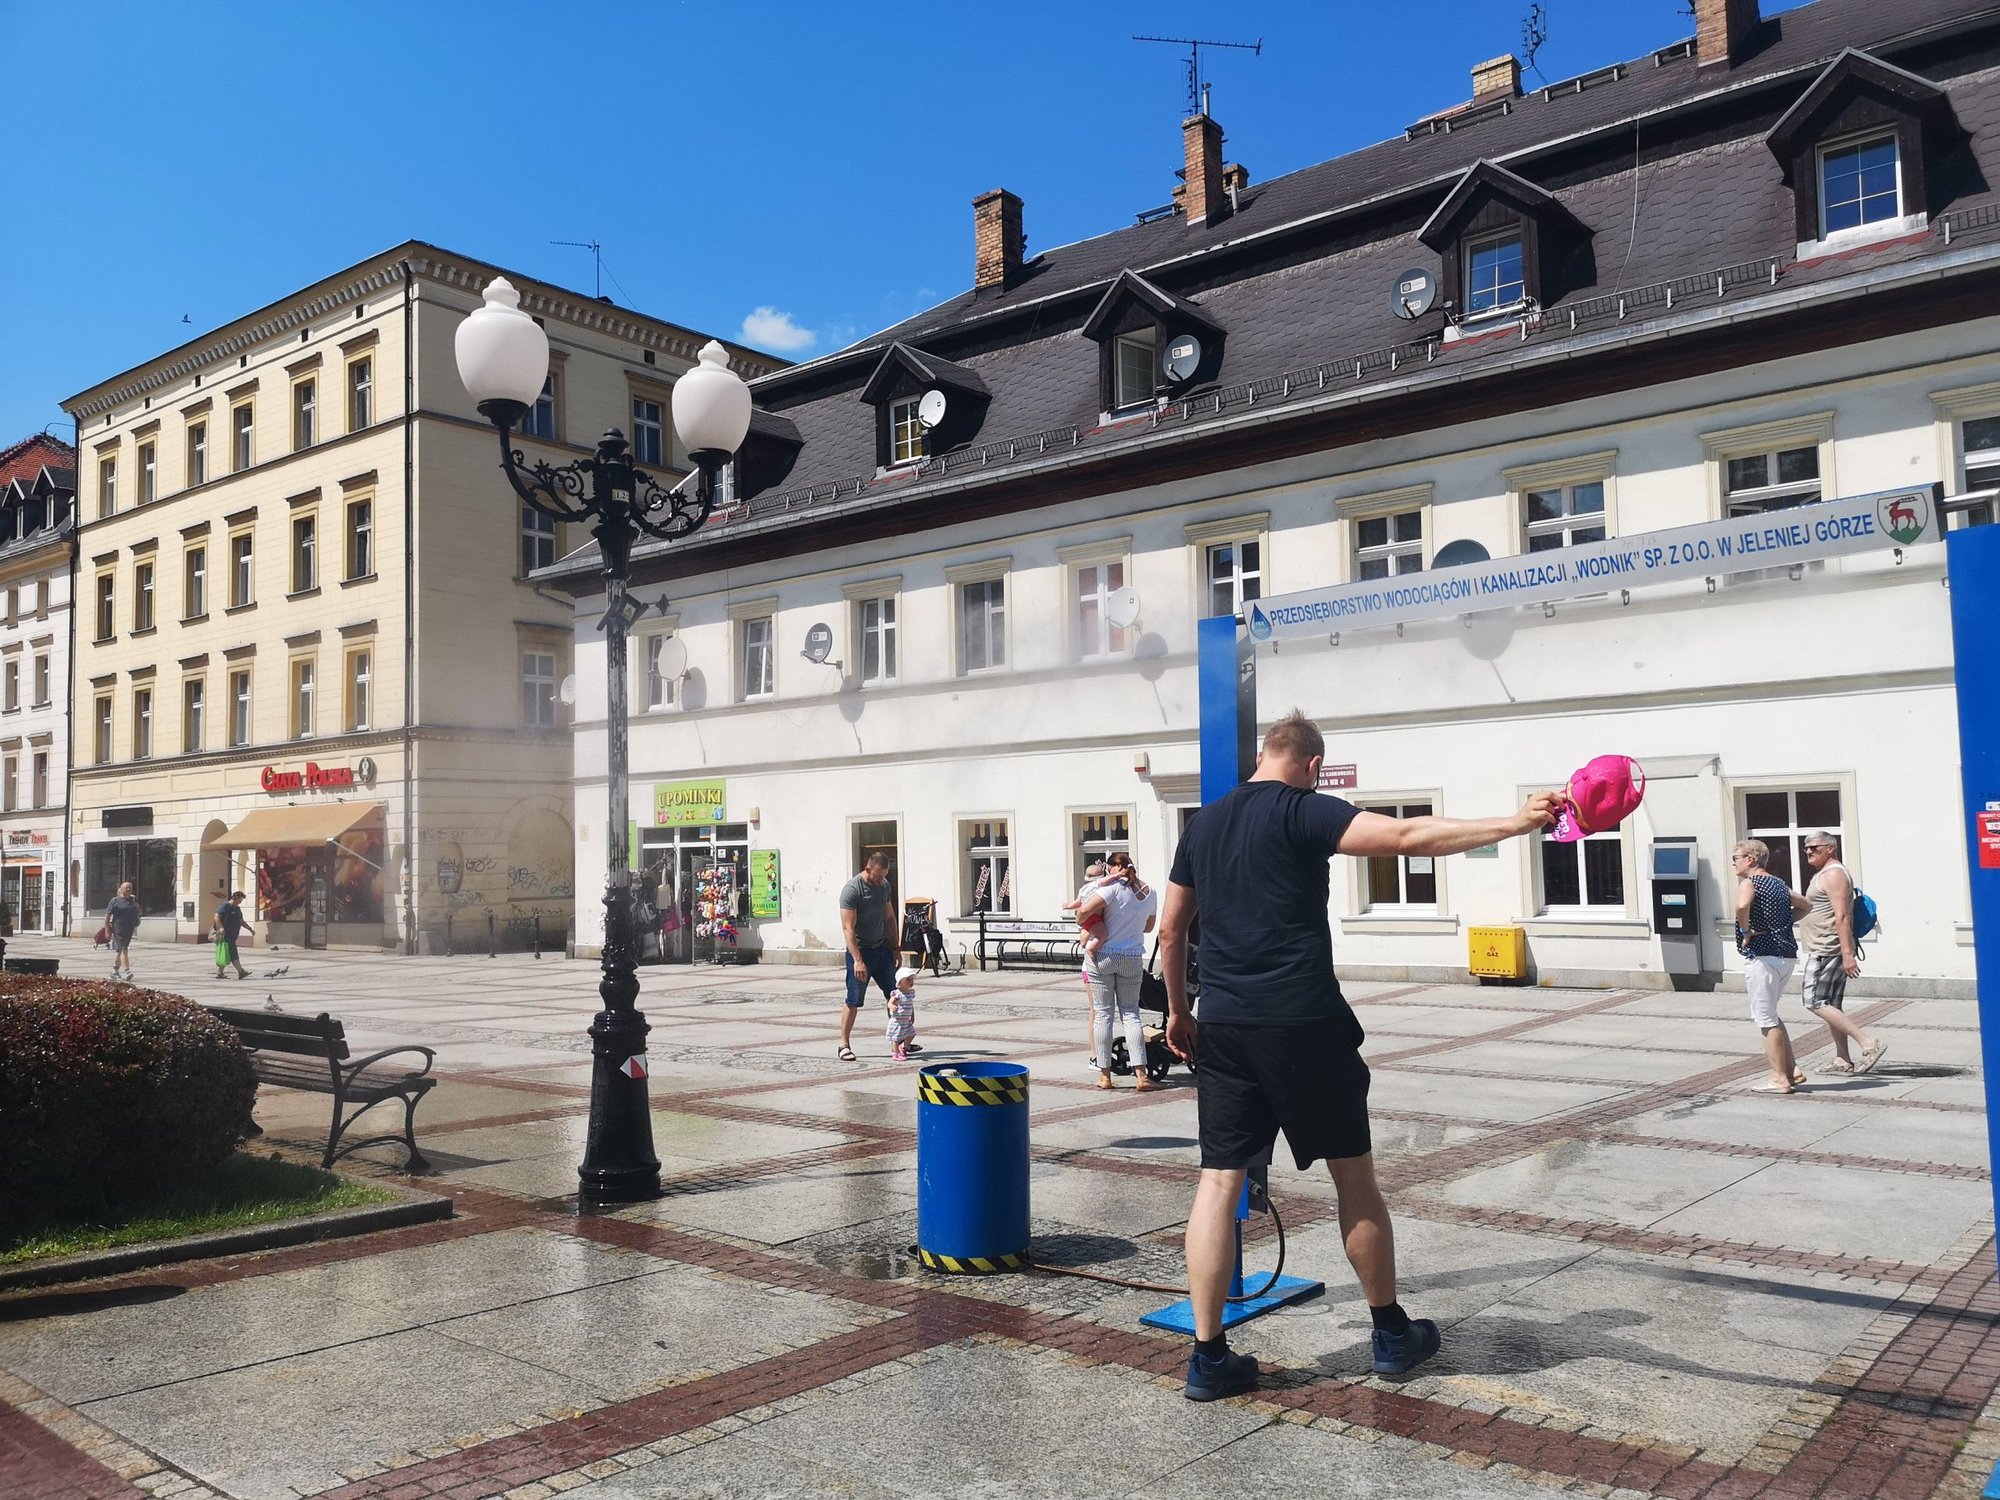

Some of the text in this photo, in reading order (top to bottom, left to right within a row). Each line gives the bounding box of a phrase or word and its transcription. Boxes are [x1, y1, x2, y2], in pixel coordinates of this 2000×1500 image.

[1269, 593, 1382, 626] PRZEDSIĘBIORSTWO
[1383, 578, 1471, 609] WODOCIĄGÓW
[1474, 578, 1479, 595] I
[1481, 563, 1568, 595] KANALIZACJI
[1644, 548, 1667, 569] SP.
[1668, 545, 1680, 565] Z
[1682, 540, 1715, 562] O.O.
[1716, 536, 1732, 557] W
[1736, 523, 1811, 555] JELENIEJ
[1814, 513, 1875, 542] GÓRZE
[657, 788, 722, 808] UPOMINKI
